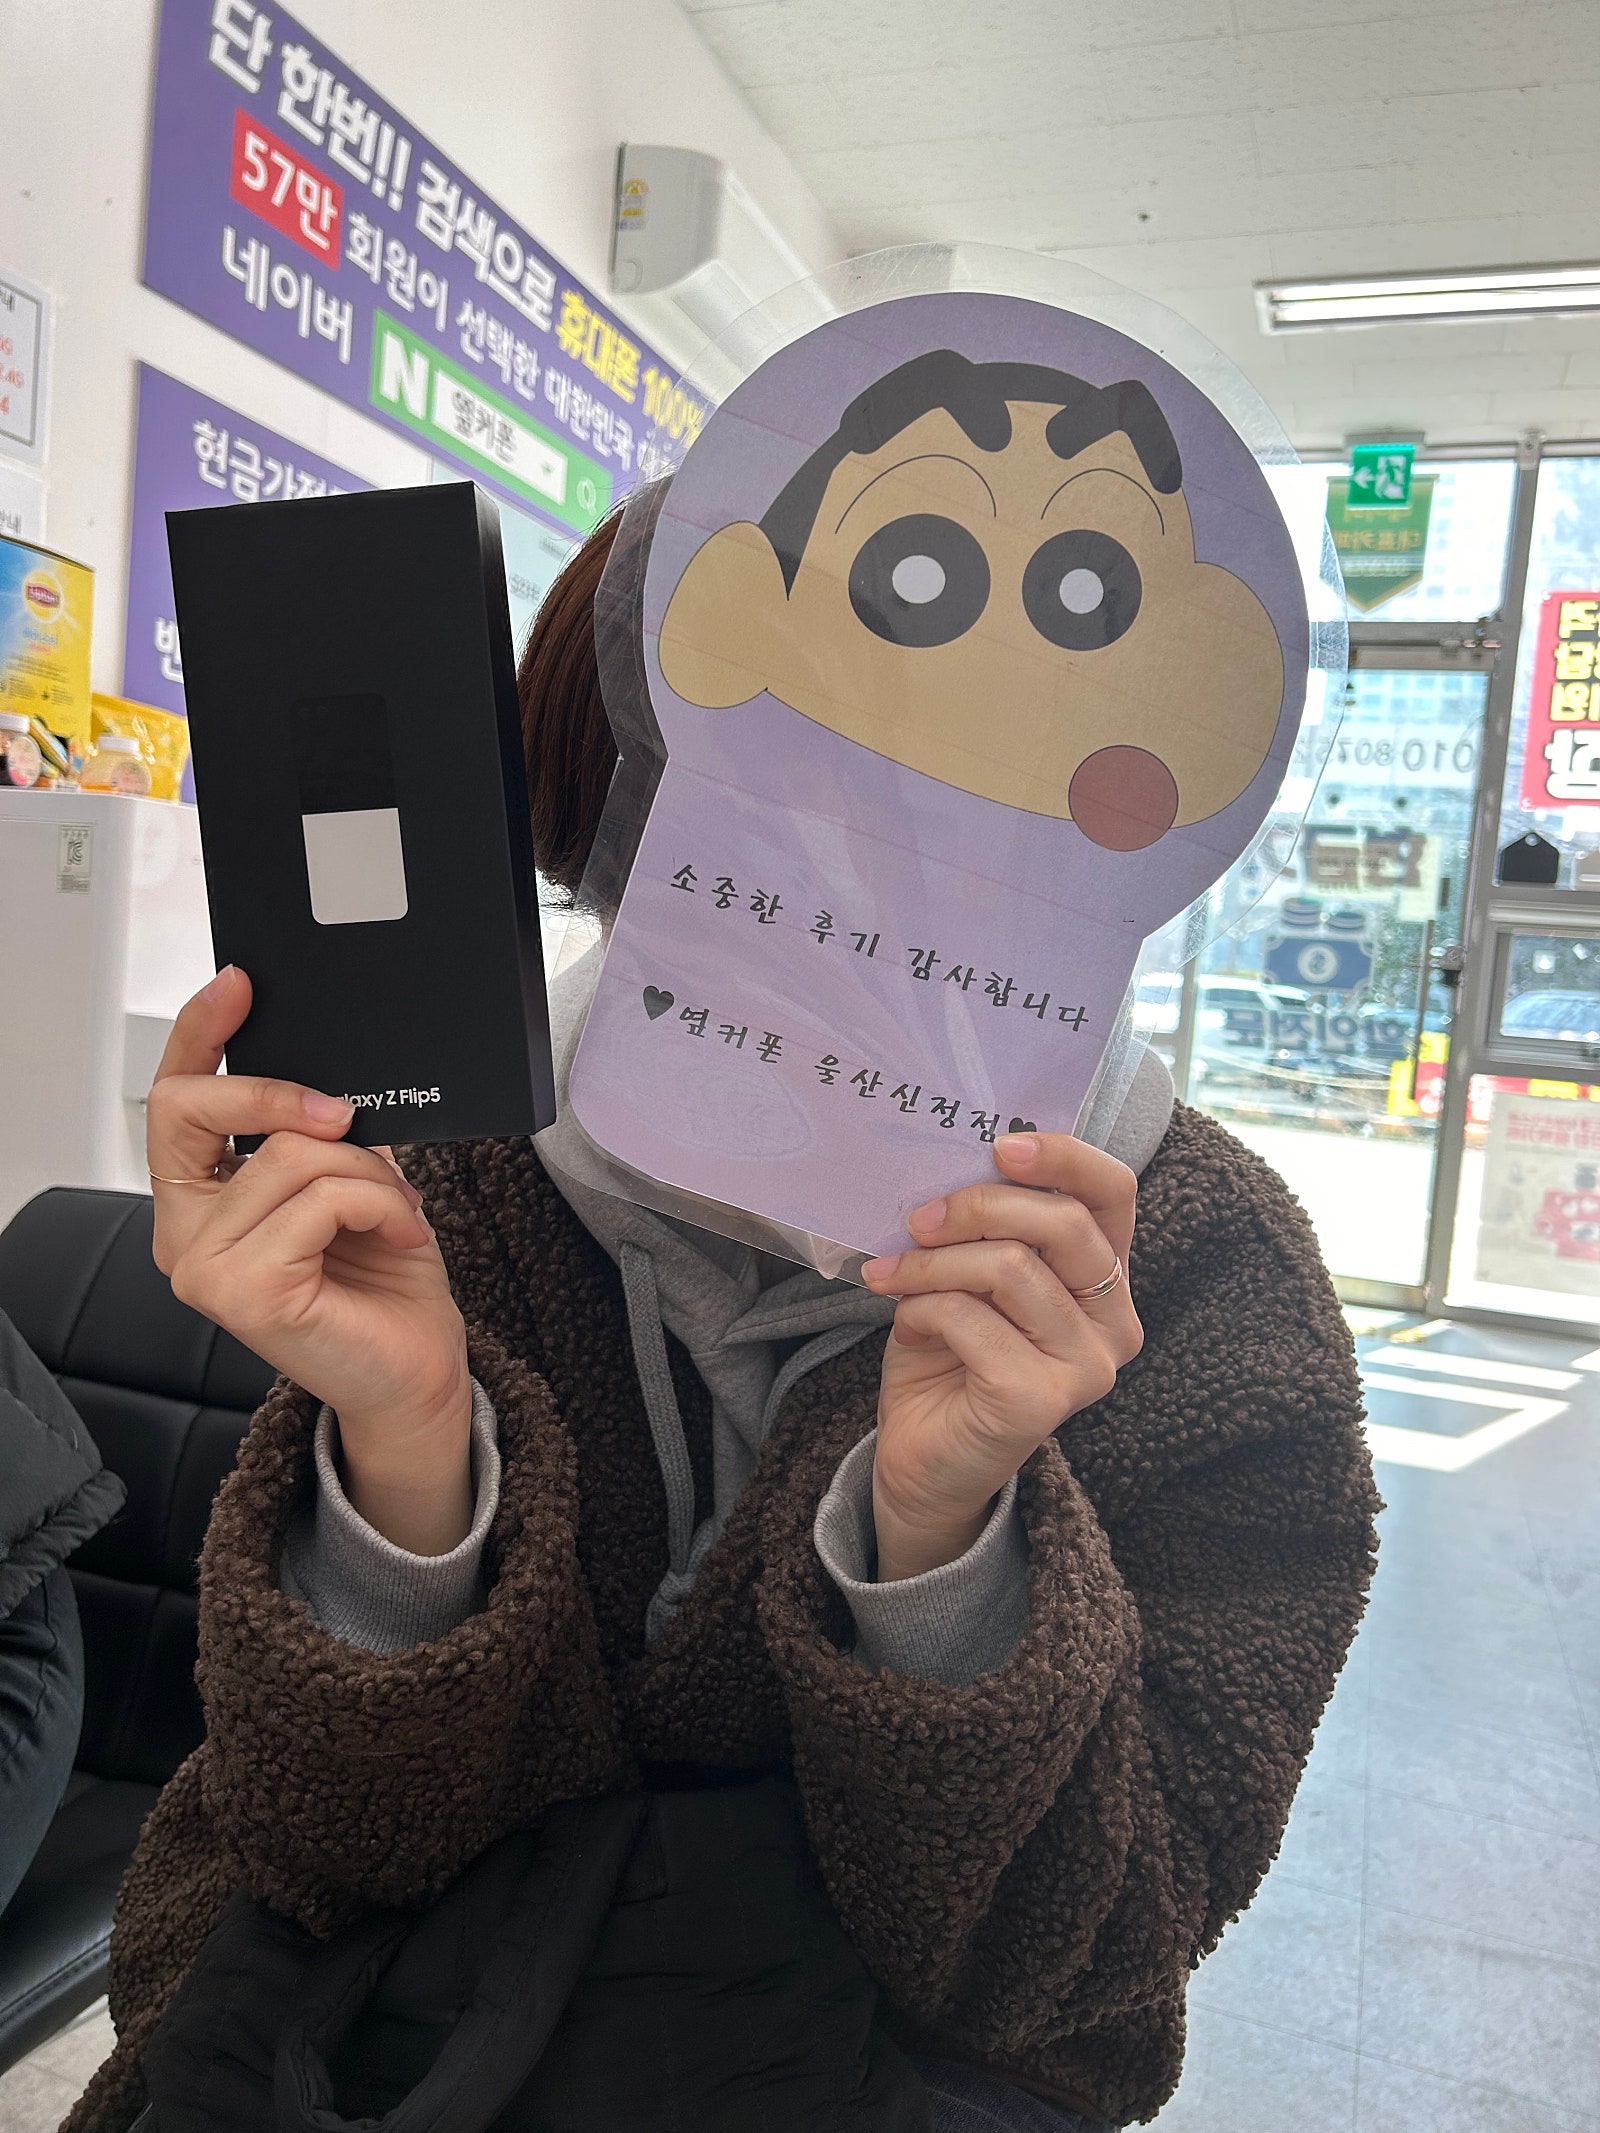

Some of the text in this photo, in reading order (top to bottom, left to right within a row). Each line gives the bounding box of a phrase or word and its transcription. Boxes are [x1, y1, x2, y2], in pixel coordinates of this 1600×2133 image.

[208, 0, 272, 94] 단
[276, 43, 413, 212] 한번!!
[415, 158, 558, 334] 검색으로
[555, 289, 642, 404] 휴대폰
[221, 225, 353, 366] 네이버
[378, 329, 429, 421] N
[240, 130, 339, 251] 57만
[345, 209, 449, 332] 회원이
[455, 299, 543, 401] 선택한
[544, 367, 636, 472] 대한민국
[670, 863, 1090, 1032] 소중한 후기 감사합니다
[337, 1086, 441, 1110] laxy Z Flip5
[678, 1004, 1001, 1143] 옆커폰 울산신정점
